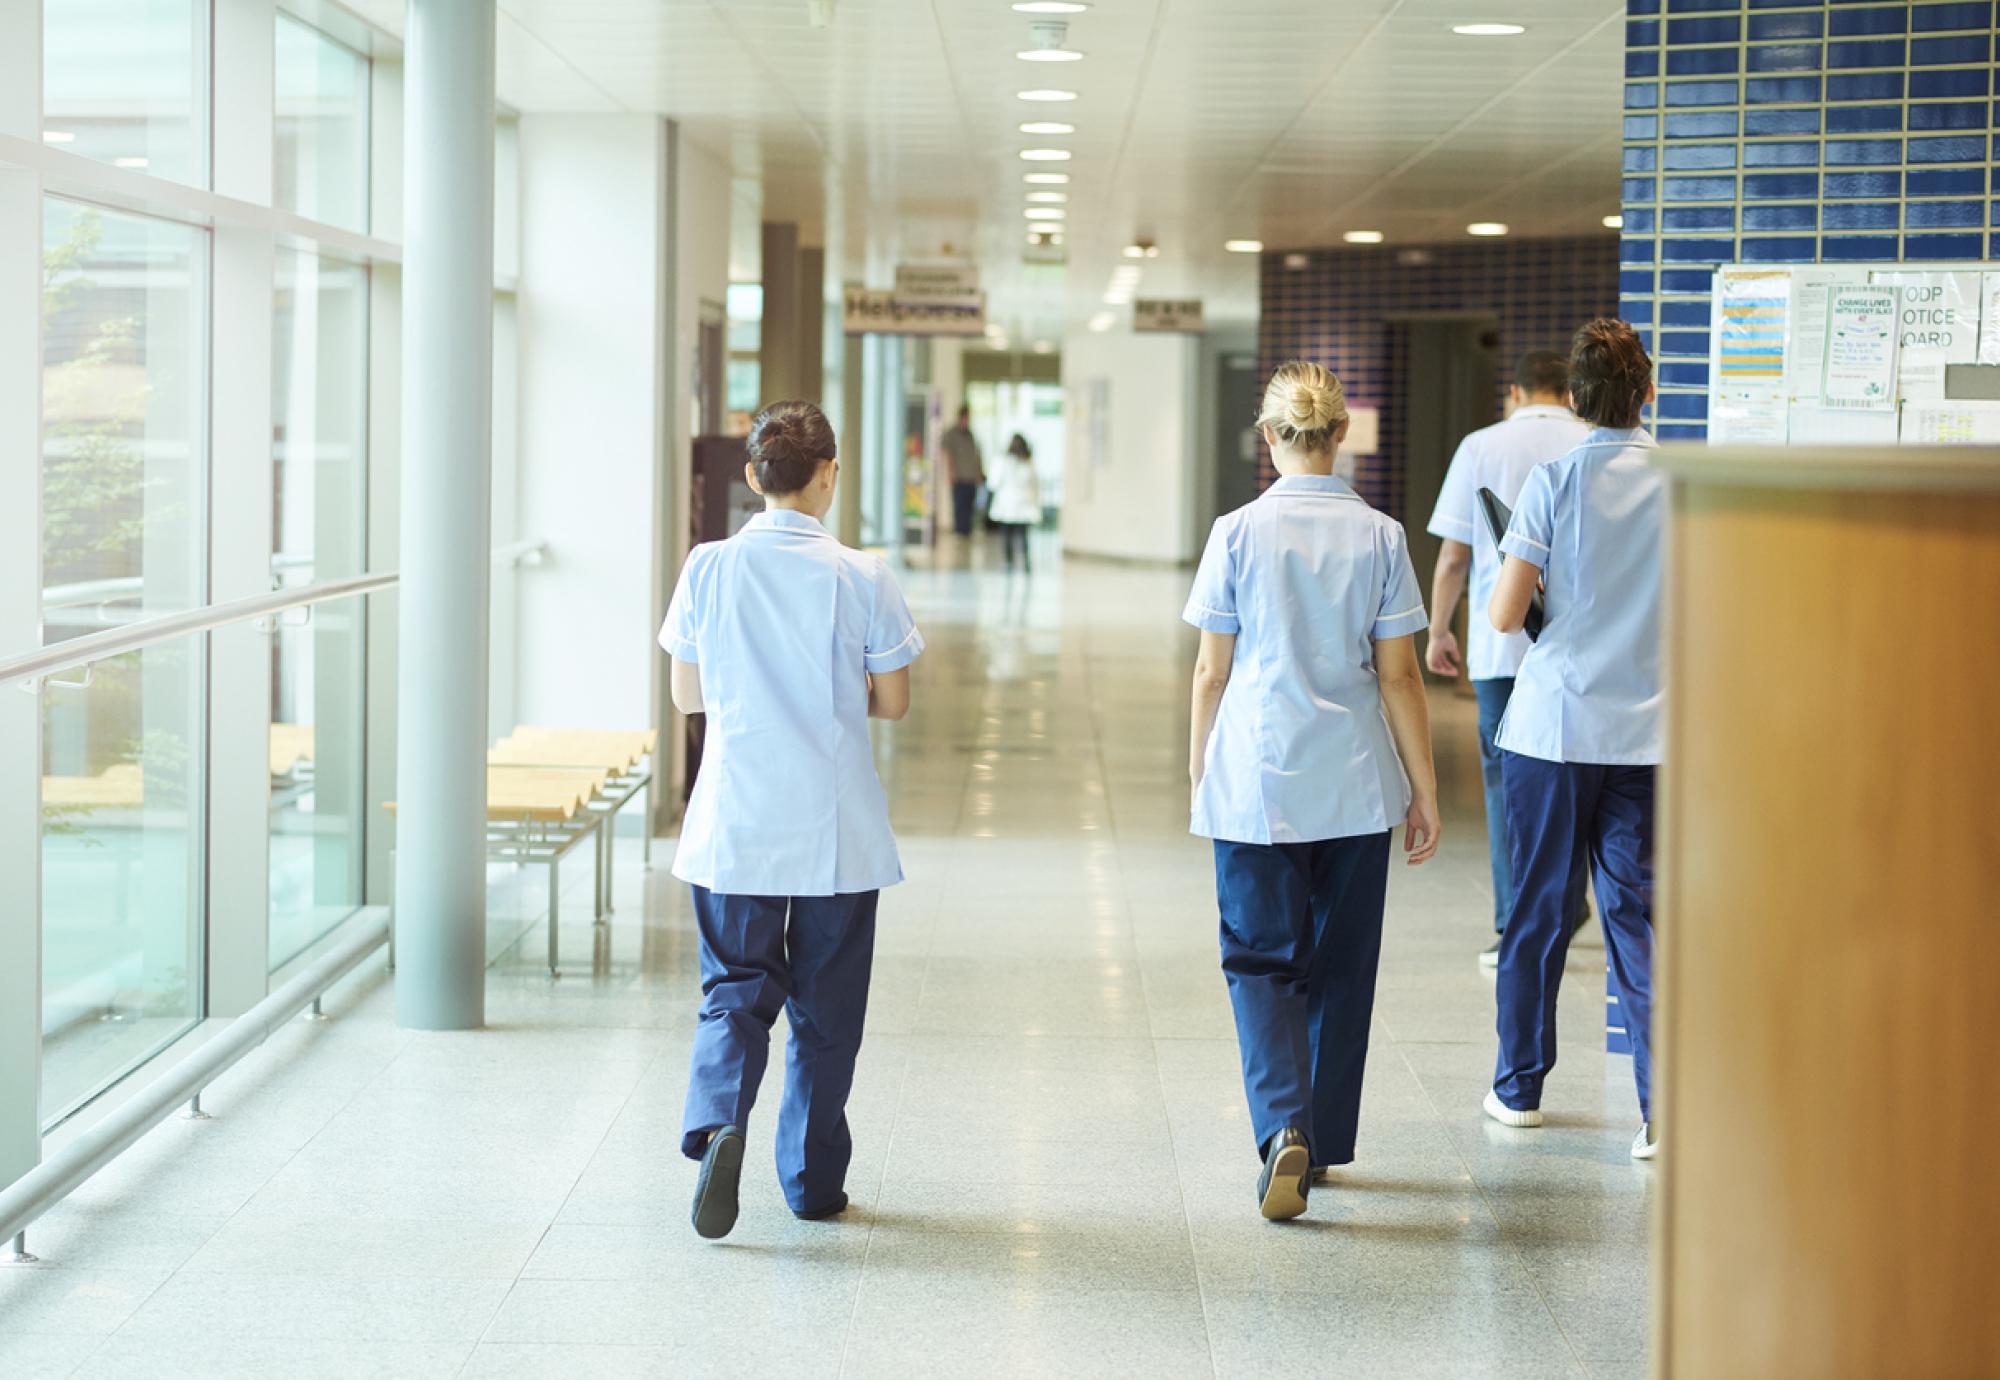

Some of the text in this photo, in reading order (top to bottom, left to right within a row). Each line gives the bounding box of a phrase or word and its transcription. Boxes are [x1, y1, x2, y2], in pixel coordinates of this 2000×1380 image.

[1905, 286, 1943, 302] ODP
[1837, 298, 1891, 307] CHANGE LIVES
[1903, 309, 1954, 325] OTICE
[1903, 331, 1952, 347] OARD
